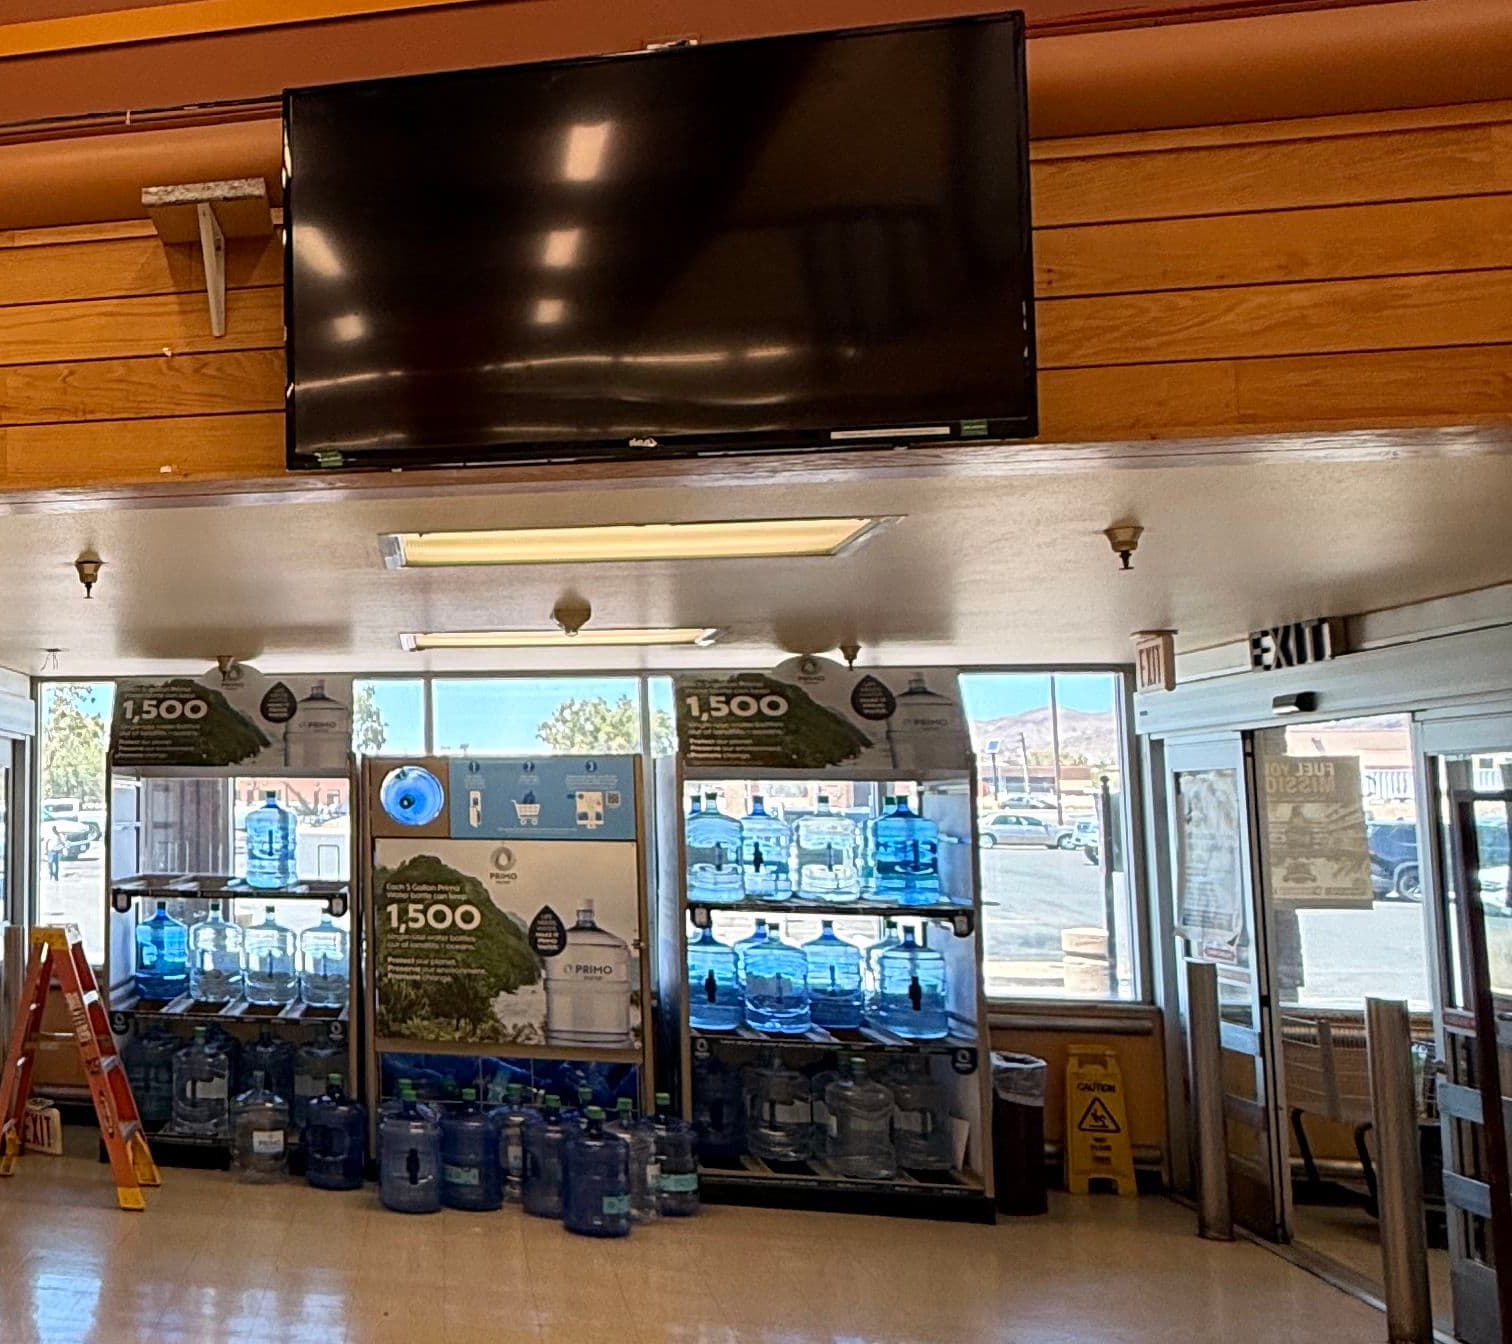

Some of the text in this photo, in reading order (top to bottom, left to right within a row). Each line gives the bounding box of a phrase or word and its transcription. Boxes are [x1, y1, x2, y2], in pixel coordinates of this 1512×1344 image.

[1250, 617, 1331, 673] EXIT
[1139, 644, 1161, 688] EXIT
[123, 699, 208, 723] 1,500
[686, 695, 788, 721] 1,500
[387, 903, 481, 933] 1,500
[576, 965, 612, 974] PRIMO
[1077, 1083, 1116, 1092] CAUTION
[23, 1111, 51, 1147] EXIT
